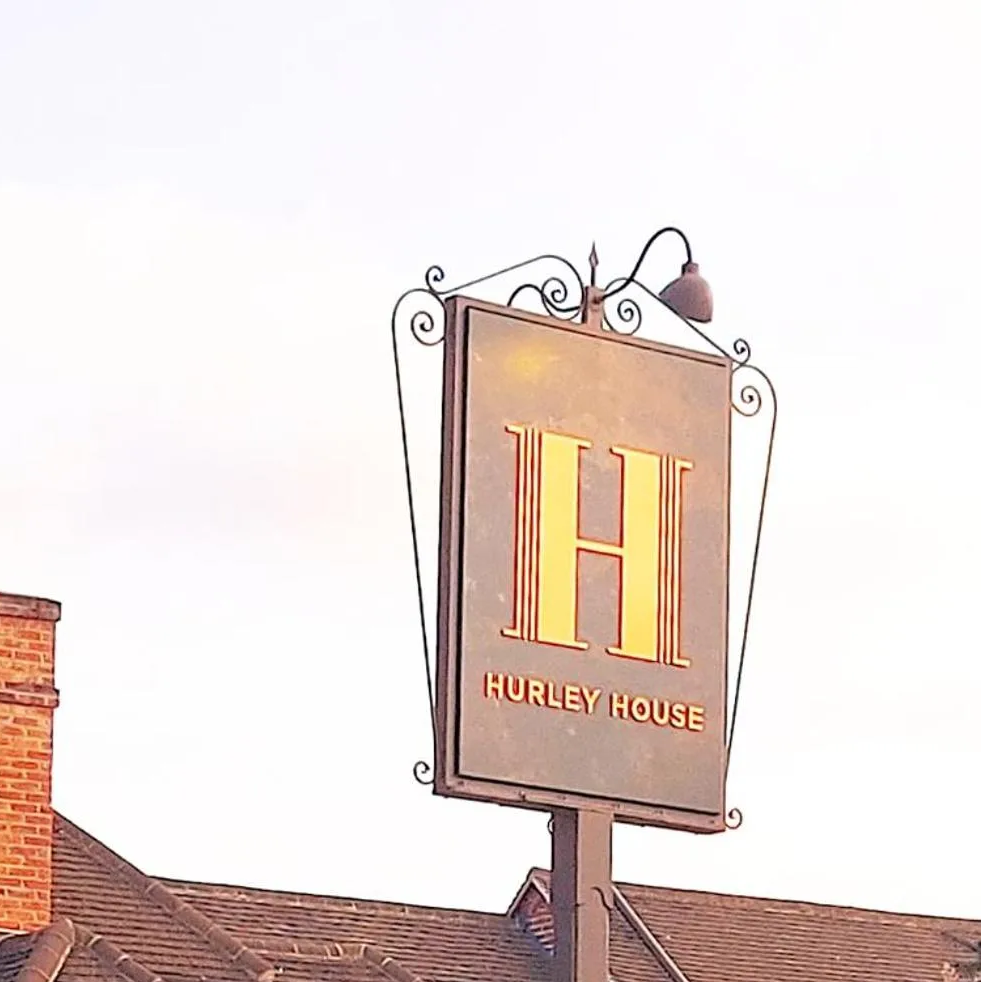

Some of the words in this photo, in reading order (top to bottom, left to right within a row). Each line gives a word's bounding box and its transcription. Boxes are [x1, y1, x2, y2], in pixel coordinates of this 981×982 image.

[501, 424, 694, 669] H
[484, 671, 601, 715] HURLEY
[610, 691, 705, 731] HOUSE
